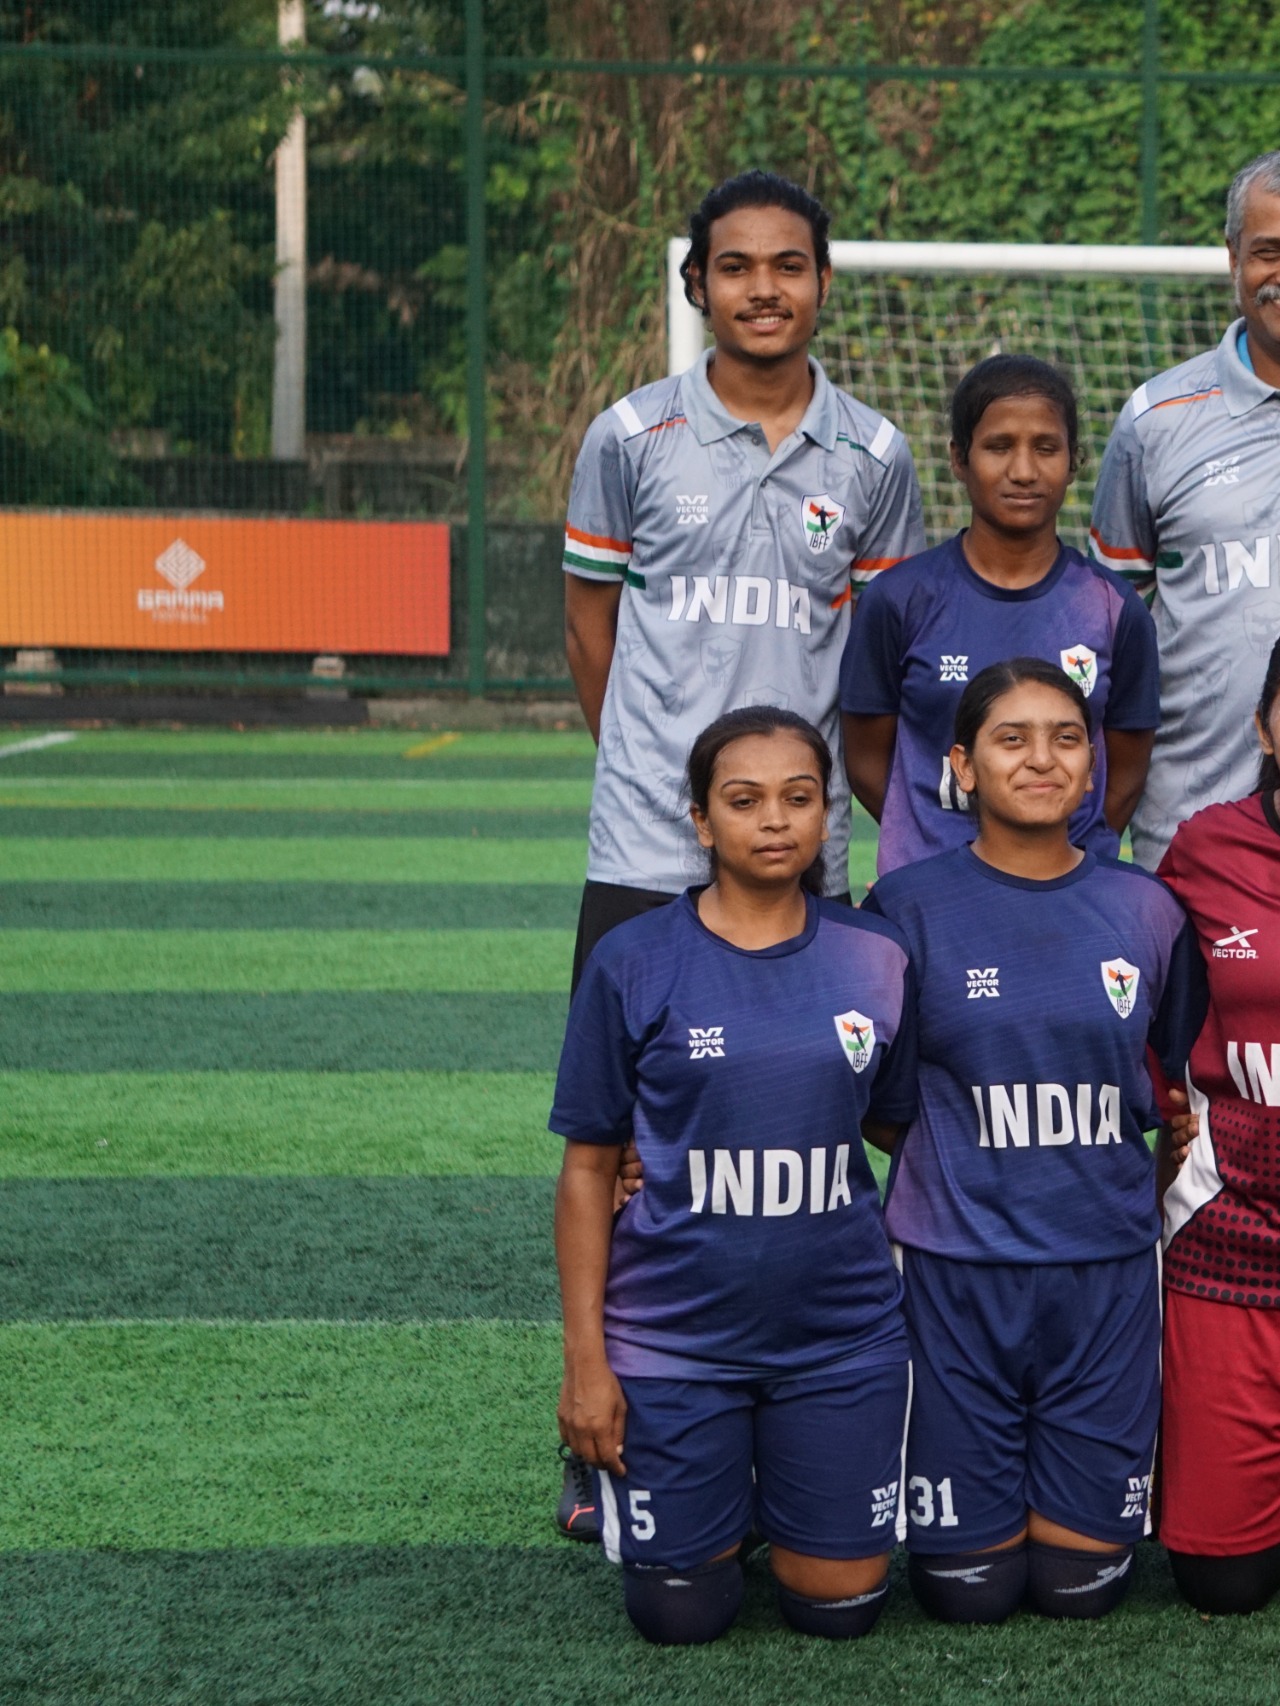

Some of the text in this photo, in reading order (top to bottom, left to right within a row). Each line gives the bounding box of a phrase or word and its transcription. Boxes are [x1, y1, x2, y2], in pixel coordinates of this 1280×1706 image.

[808, 533, 829, 550] IBFF
[137, 588, 224, 612] GAMMA
[667, 575, 812, 635] INDIA
[1212, 948, 1256, 959] VECTOR
[967, 979, 999, 988] VECTOR
[1116, 998, 1131, 1014] IBFF
[688, 1037, 724, 1047] VECTOR
[852, 1051, 868, 1070] IBFF
[972, 1083, 1122, 1148] INDIA
[688, 1143, 852, 1217] INDIA
[909, 1475, 958, 1527] 31
[628, 1490, 656, 1541] 5
